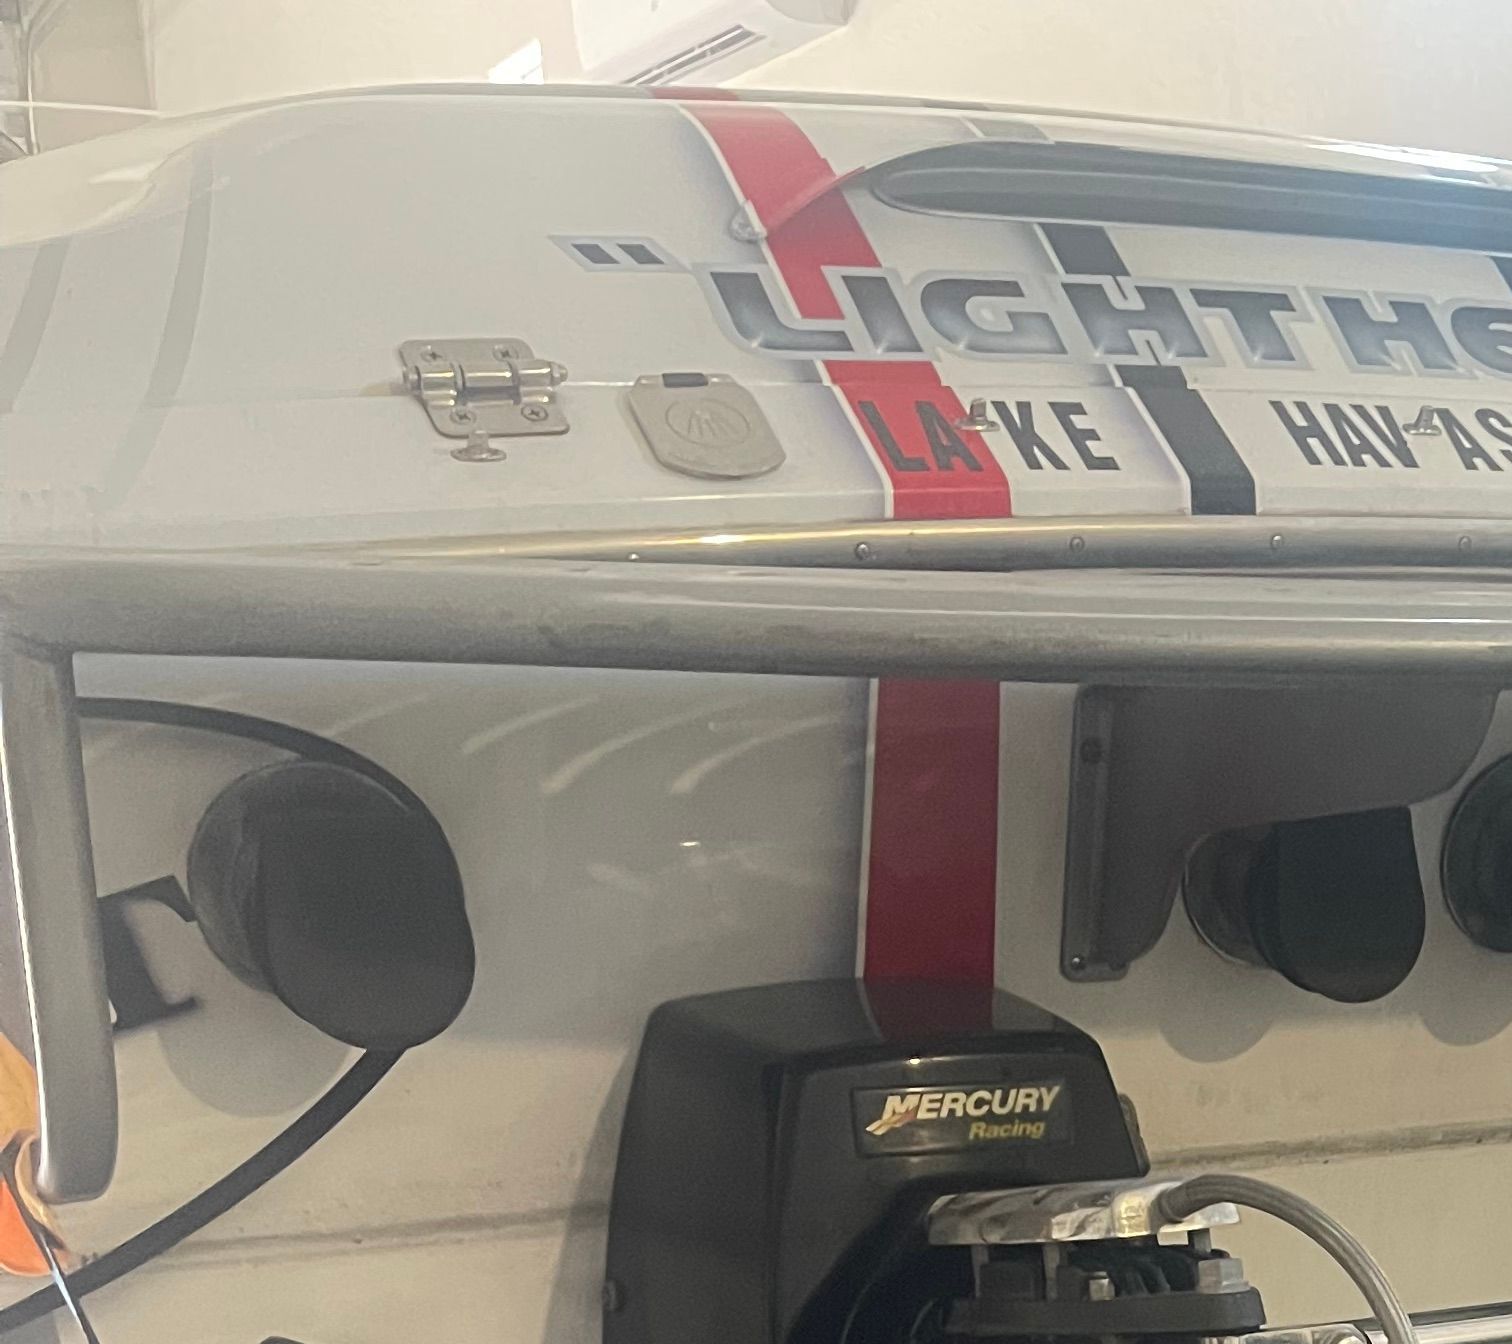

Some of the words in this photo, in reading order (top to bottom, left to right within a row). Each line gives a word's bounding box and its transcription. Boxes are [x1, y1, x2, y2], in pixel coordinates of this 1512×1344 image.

[859, 400, 1120, 472] LAKE
[865, 1086, 1060, 1135] MERCURY
[969, 1119, 1046, 1140] Racing
